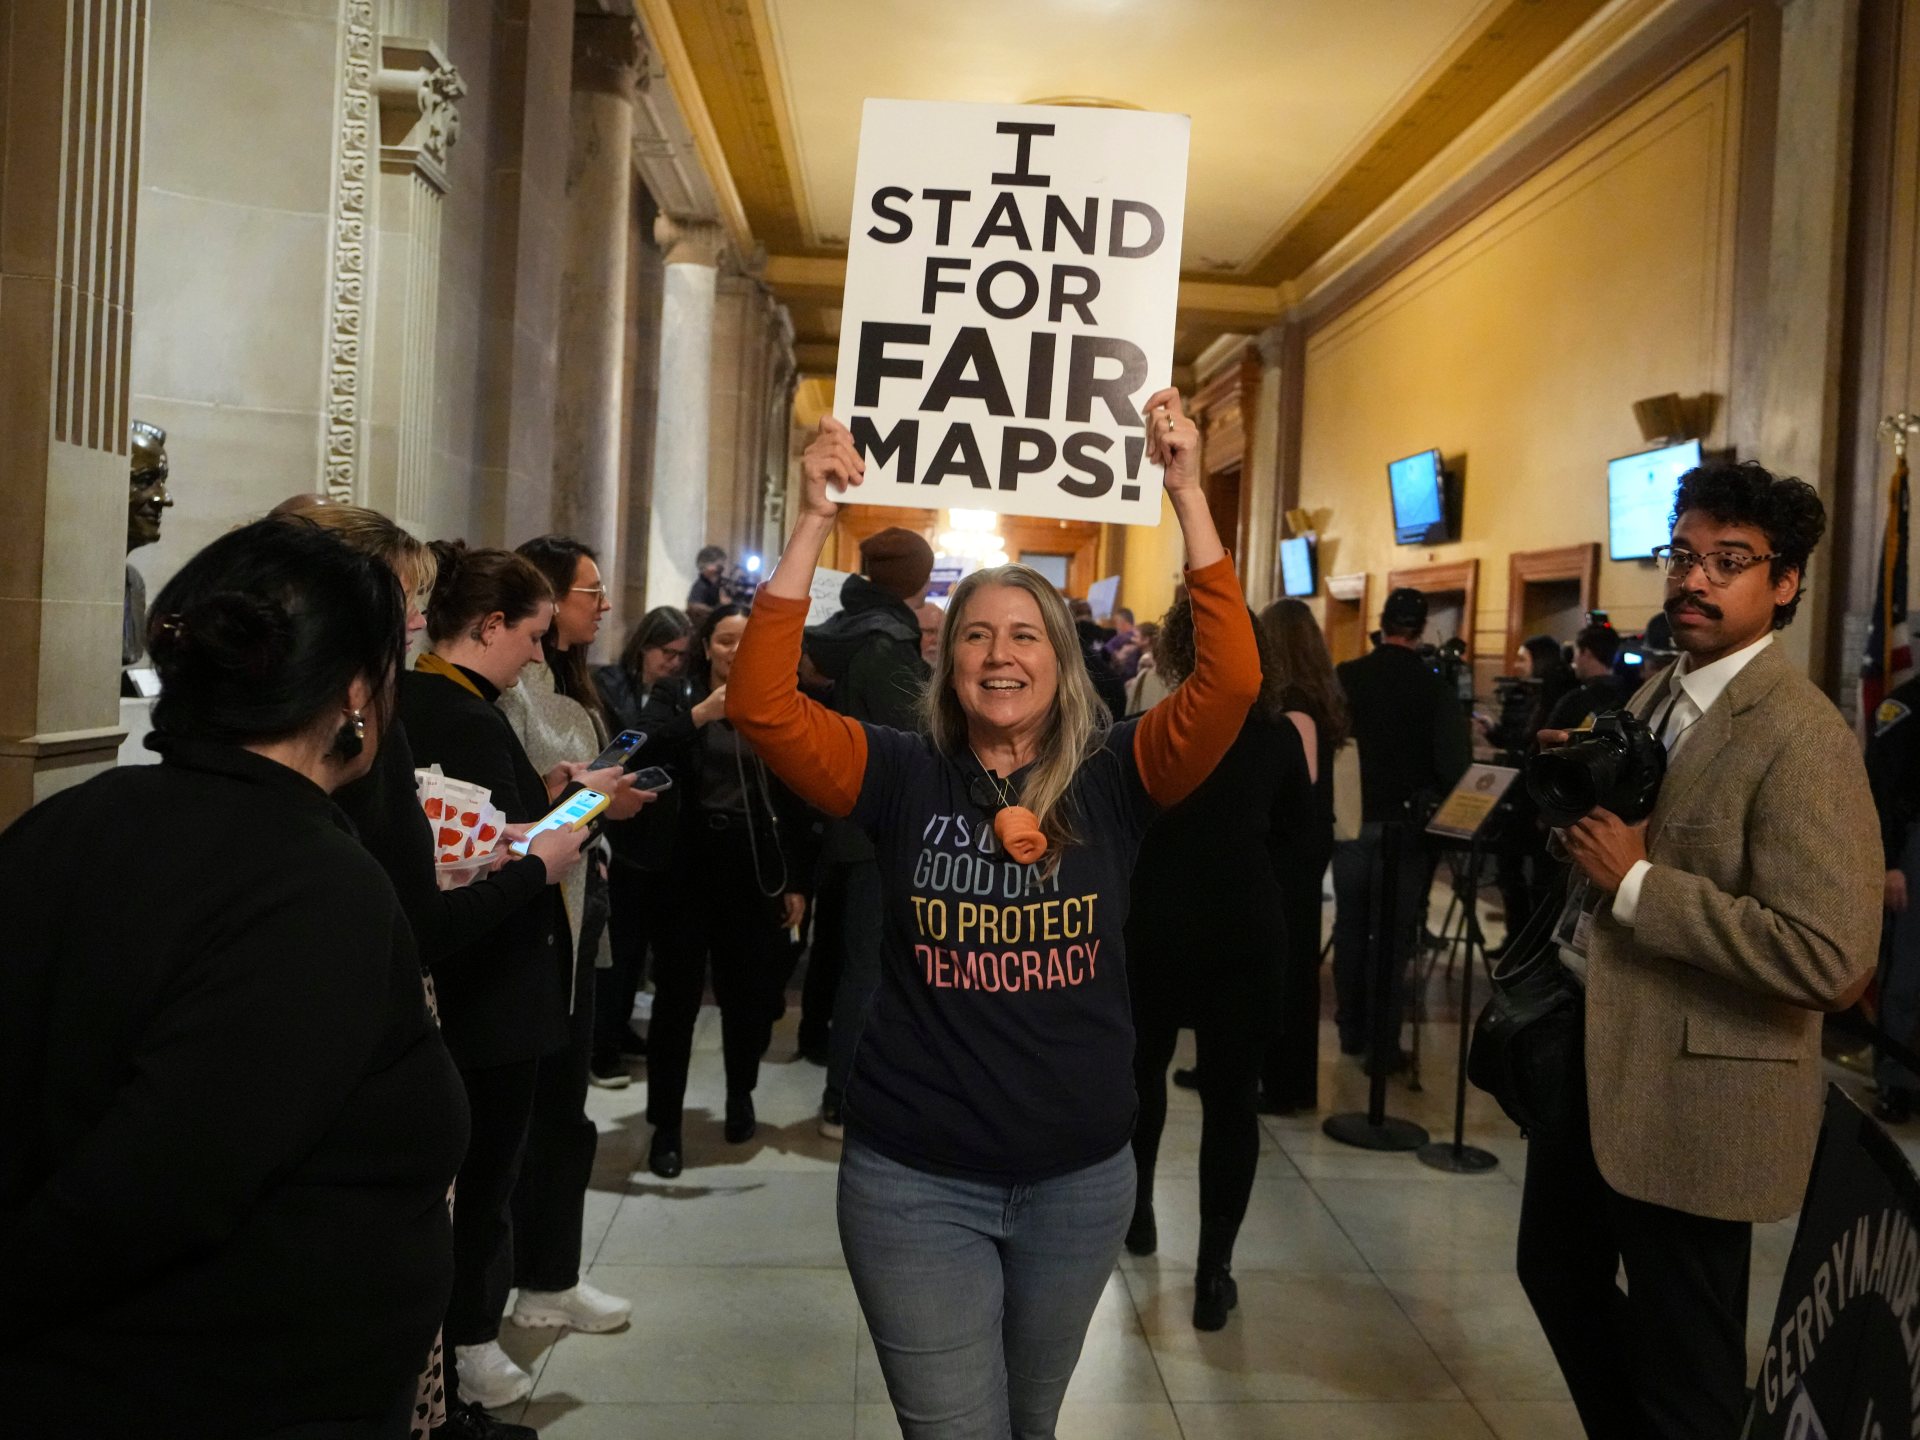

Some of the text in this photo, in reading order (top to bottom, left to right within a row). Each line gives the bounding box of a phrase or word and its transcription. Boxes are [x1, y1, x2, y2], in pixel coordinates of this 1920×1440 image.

[991, 121, 1056, 188] I
[866, 186, 1165, 259] STAND
[921, 256, 1101, 326] FOR
[854, 321, 1149, 428] FAIR
[850, 416, 1146, 501] MAPS!
[922, 812, 971, 848] IT'S
[912, 848, 994, 896] GOOD
[909, 893, 1098, 944] TO PROTECT
[914, 939, 1101, 993] DEMOCRACY
